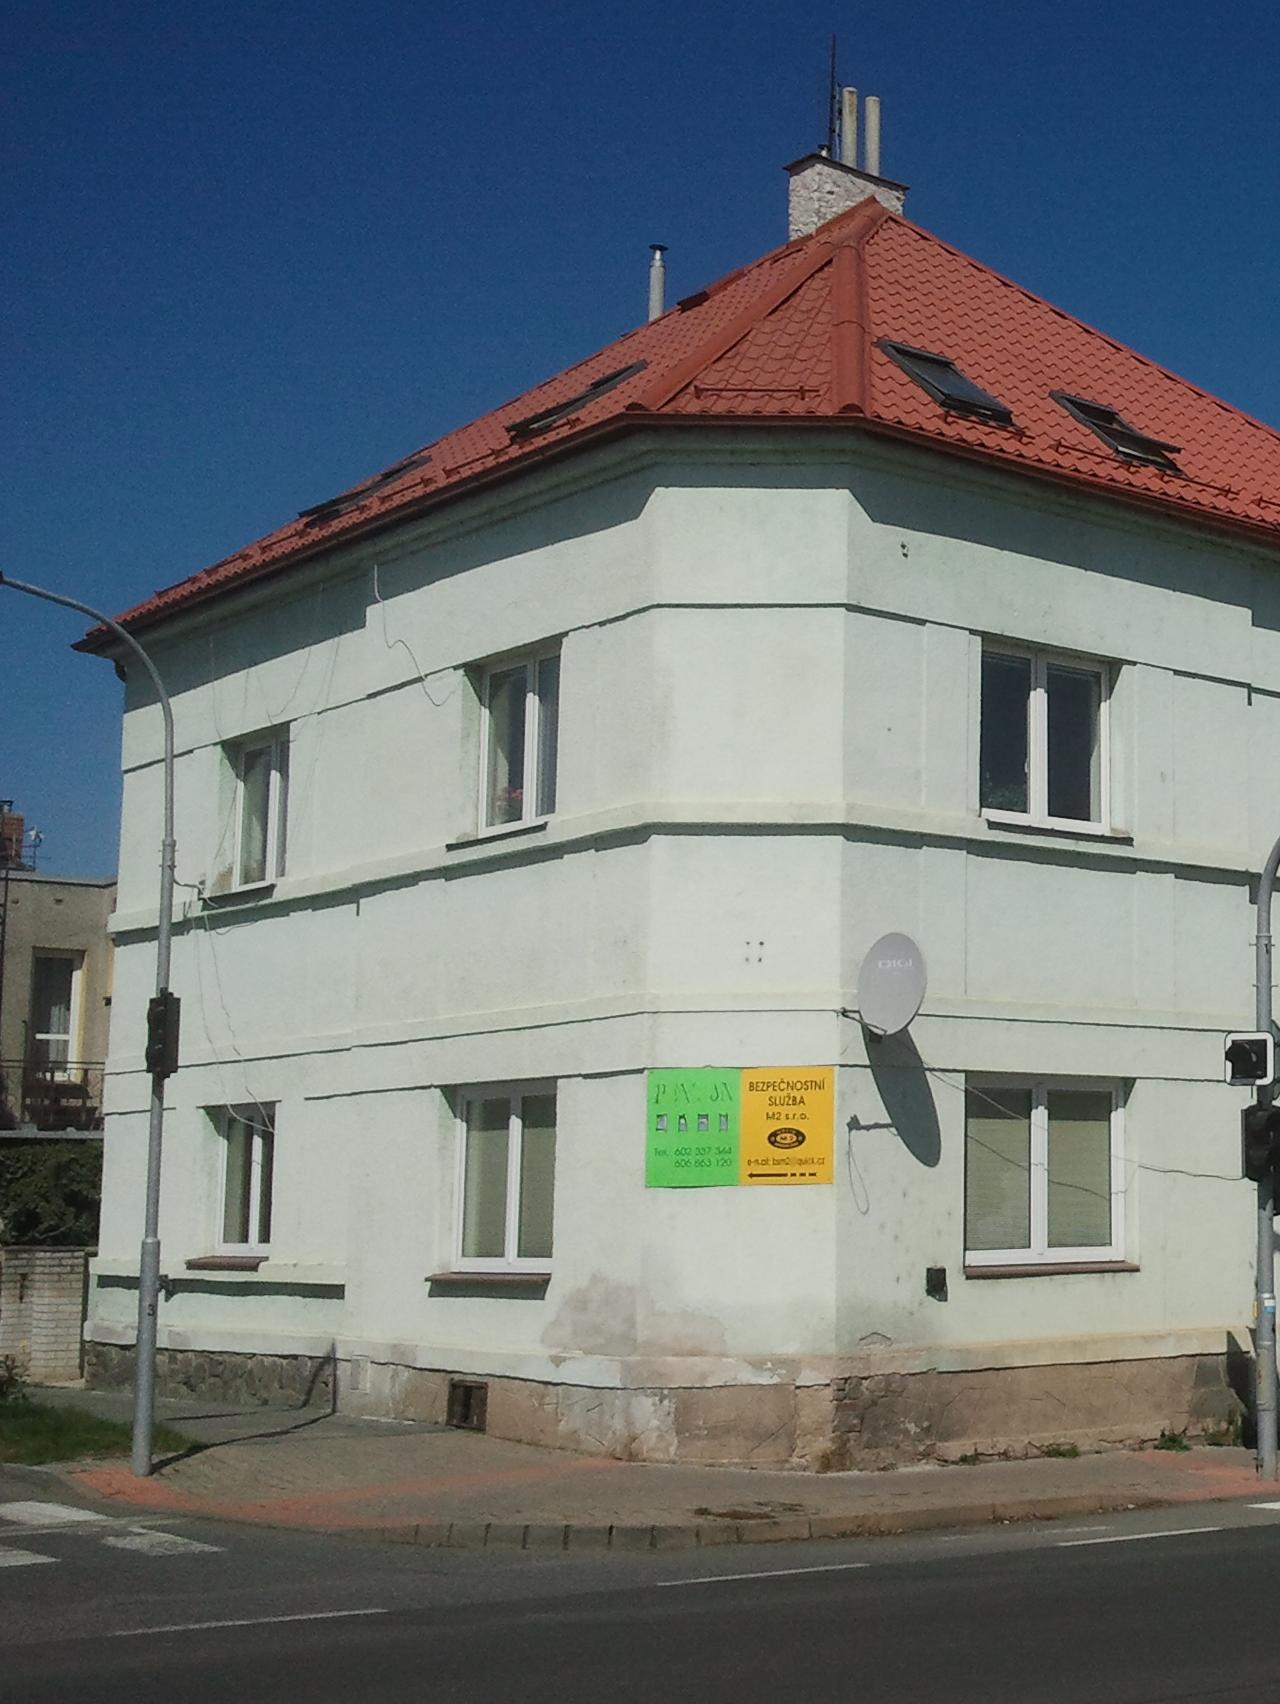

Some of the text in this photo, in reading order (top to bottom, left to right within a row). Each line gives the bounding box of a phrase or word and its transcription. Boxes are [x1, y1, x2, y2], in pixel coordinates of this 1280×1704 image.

[748, 1078, 826, 1092] BEZPEČNOSTNÍ
[768, 1093, 806, 1106] SLUŽBA
[766, 1112, 810, 1120] M2 s.r.o.
